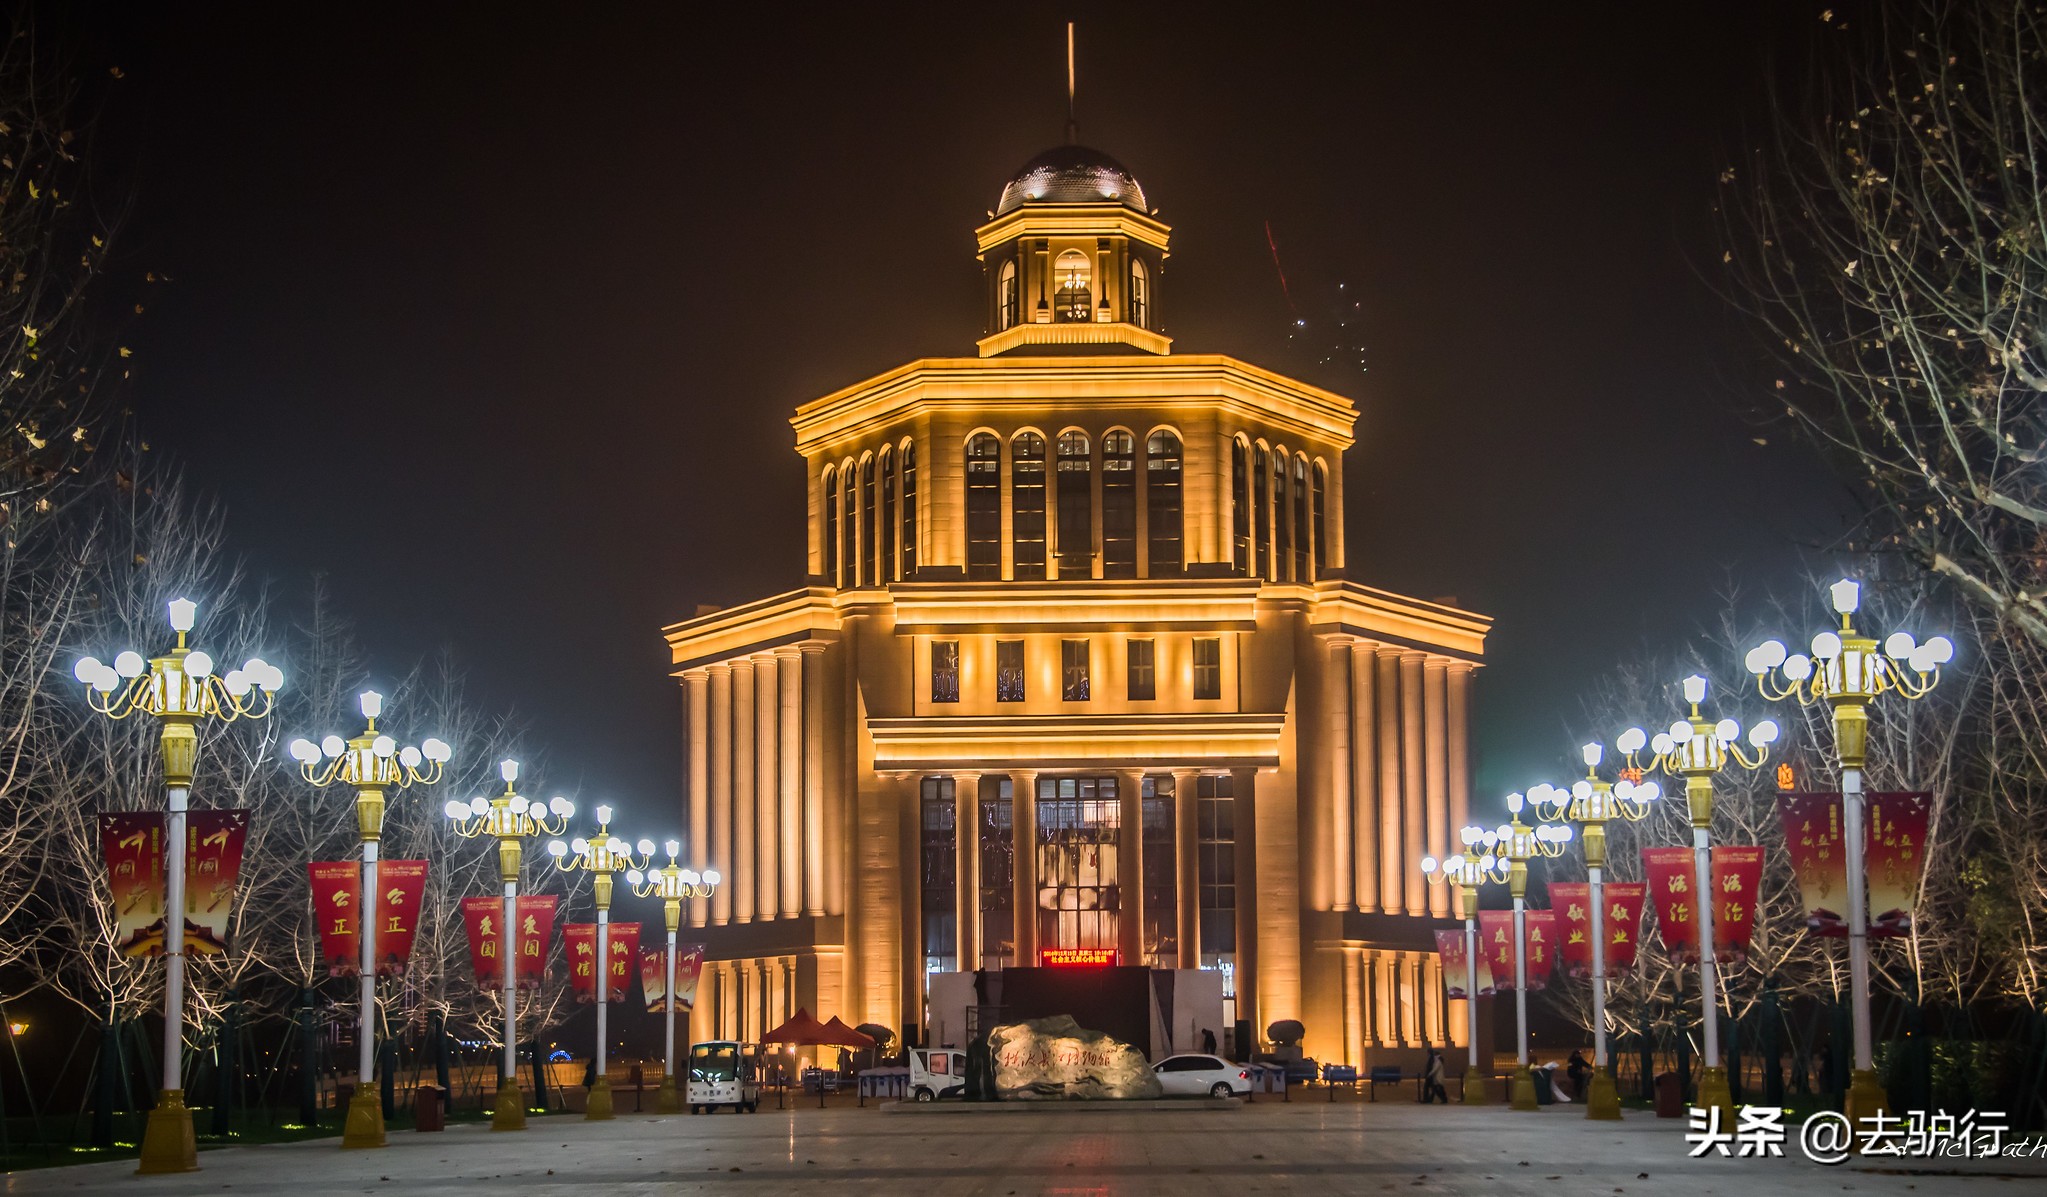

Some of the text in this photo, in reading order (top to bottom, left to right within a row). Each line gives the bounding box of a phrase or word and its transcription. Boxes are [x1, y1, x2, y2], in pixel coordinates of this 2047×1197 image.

[330, 890, 352, 935] 公正
[384, 888, 407, 932] 公正
[1668, 874, 1688, 922] 法治
[1722, 874, 1743, 921] 法治
[1531, 926, 1545, 963] 友善
[1567, 903, 1586, 944] 敬业
[1610, 903, 1630, 944] 敬业
[1495, 927, 1509, 963] 友善
